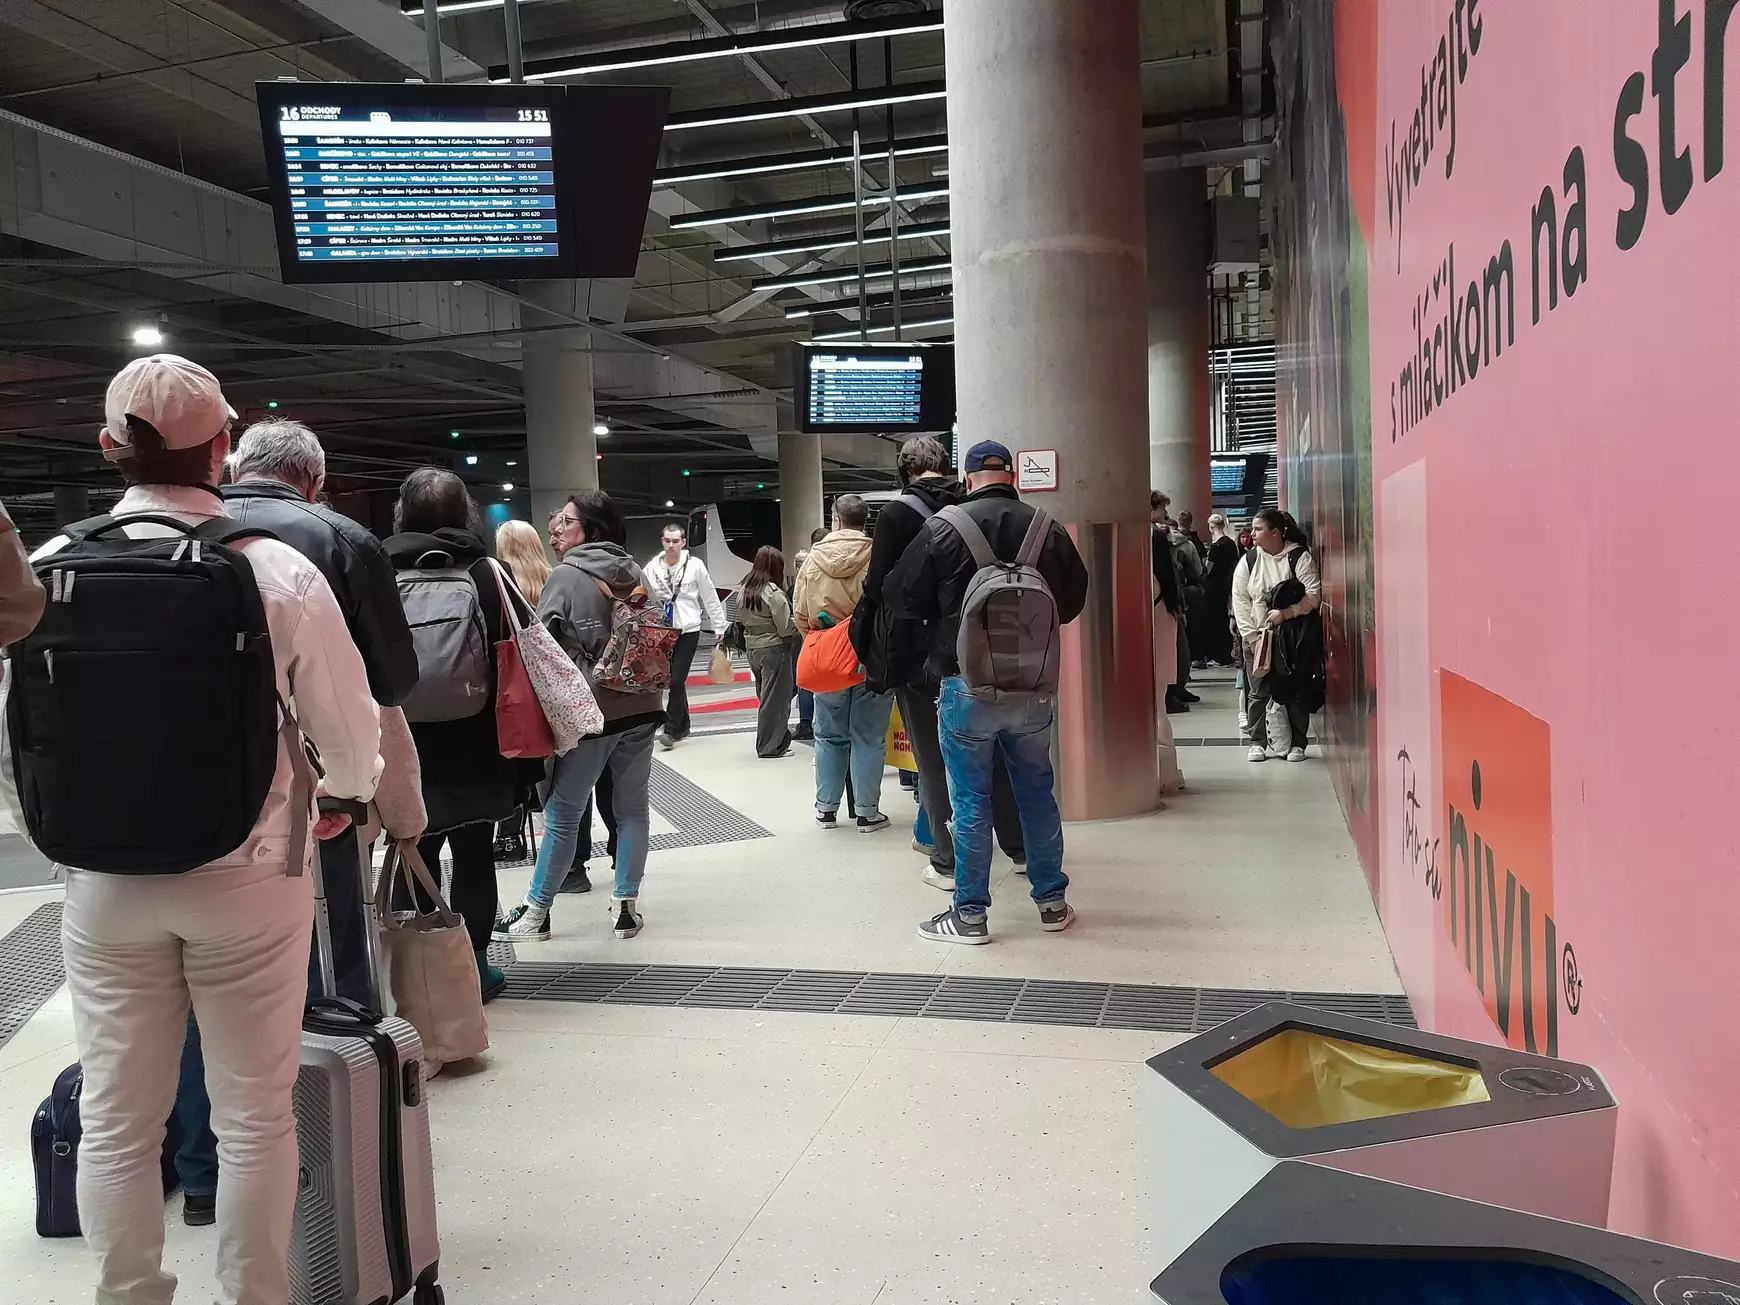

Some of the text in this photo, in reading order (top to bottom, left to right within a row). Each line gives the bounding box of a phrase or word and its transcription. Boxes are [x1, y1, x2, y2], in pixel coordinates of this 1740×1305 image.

[281, 107, 548, 121] 16 ODCHODY 15 51
[1385, 0, 1483, 275] Vyvetrajte
[1390, 380, 1397, 445] s
[1530, 145, 1588, 326] na
